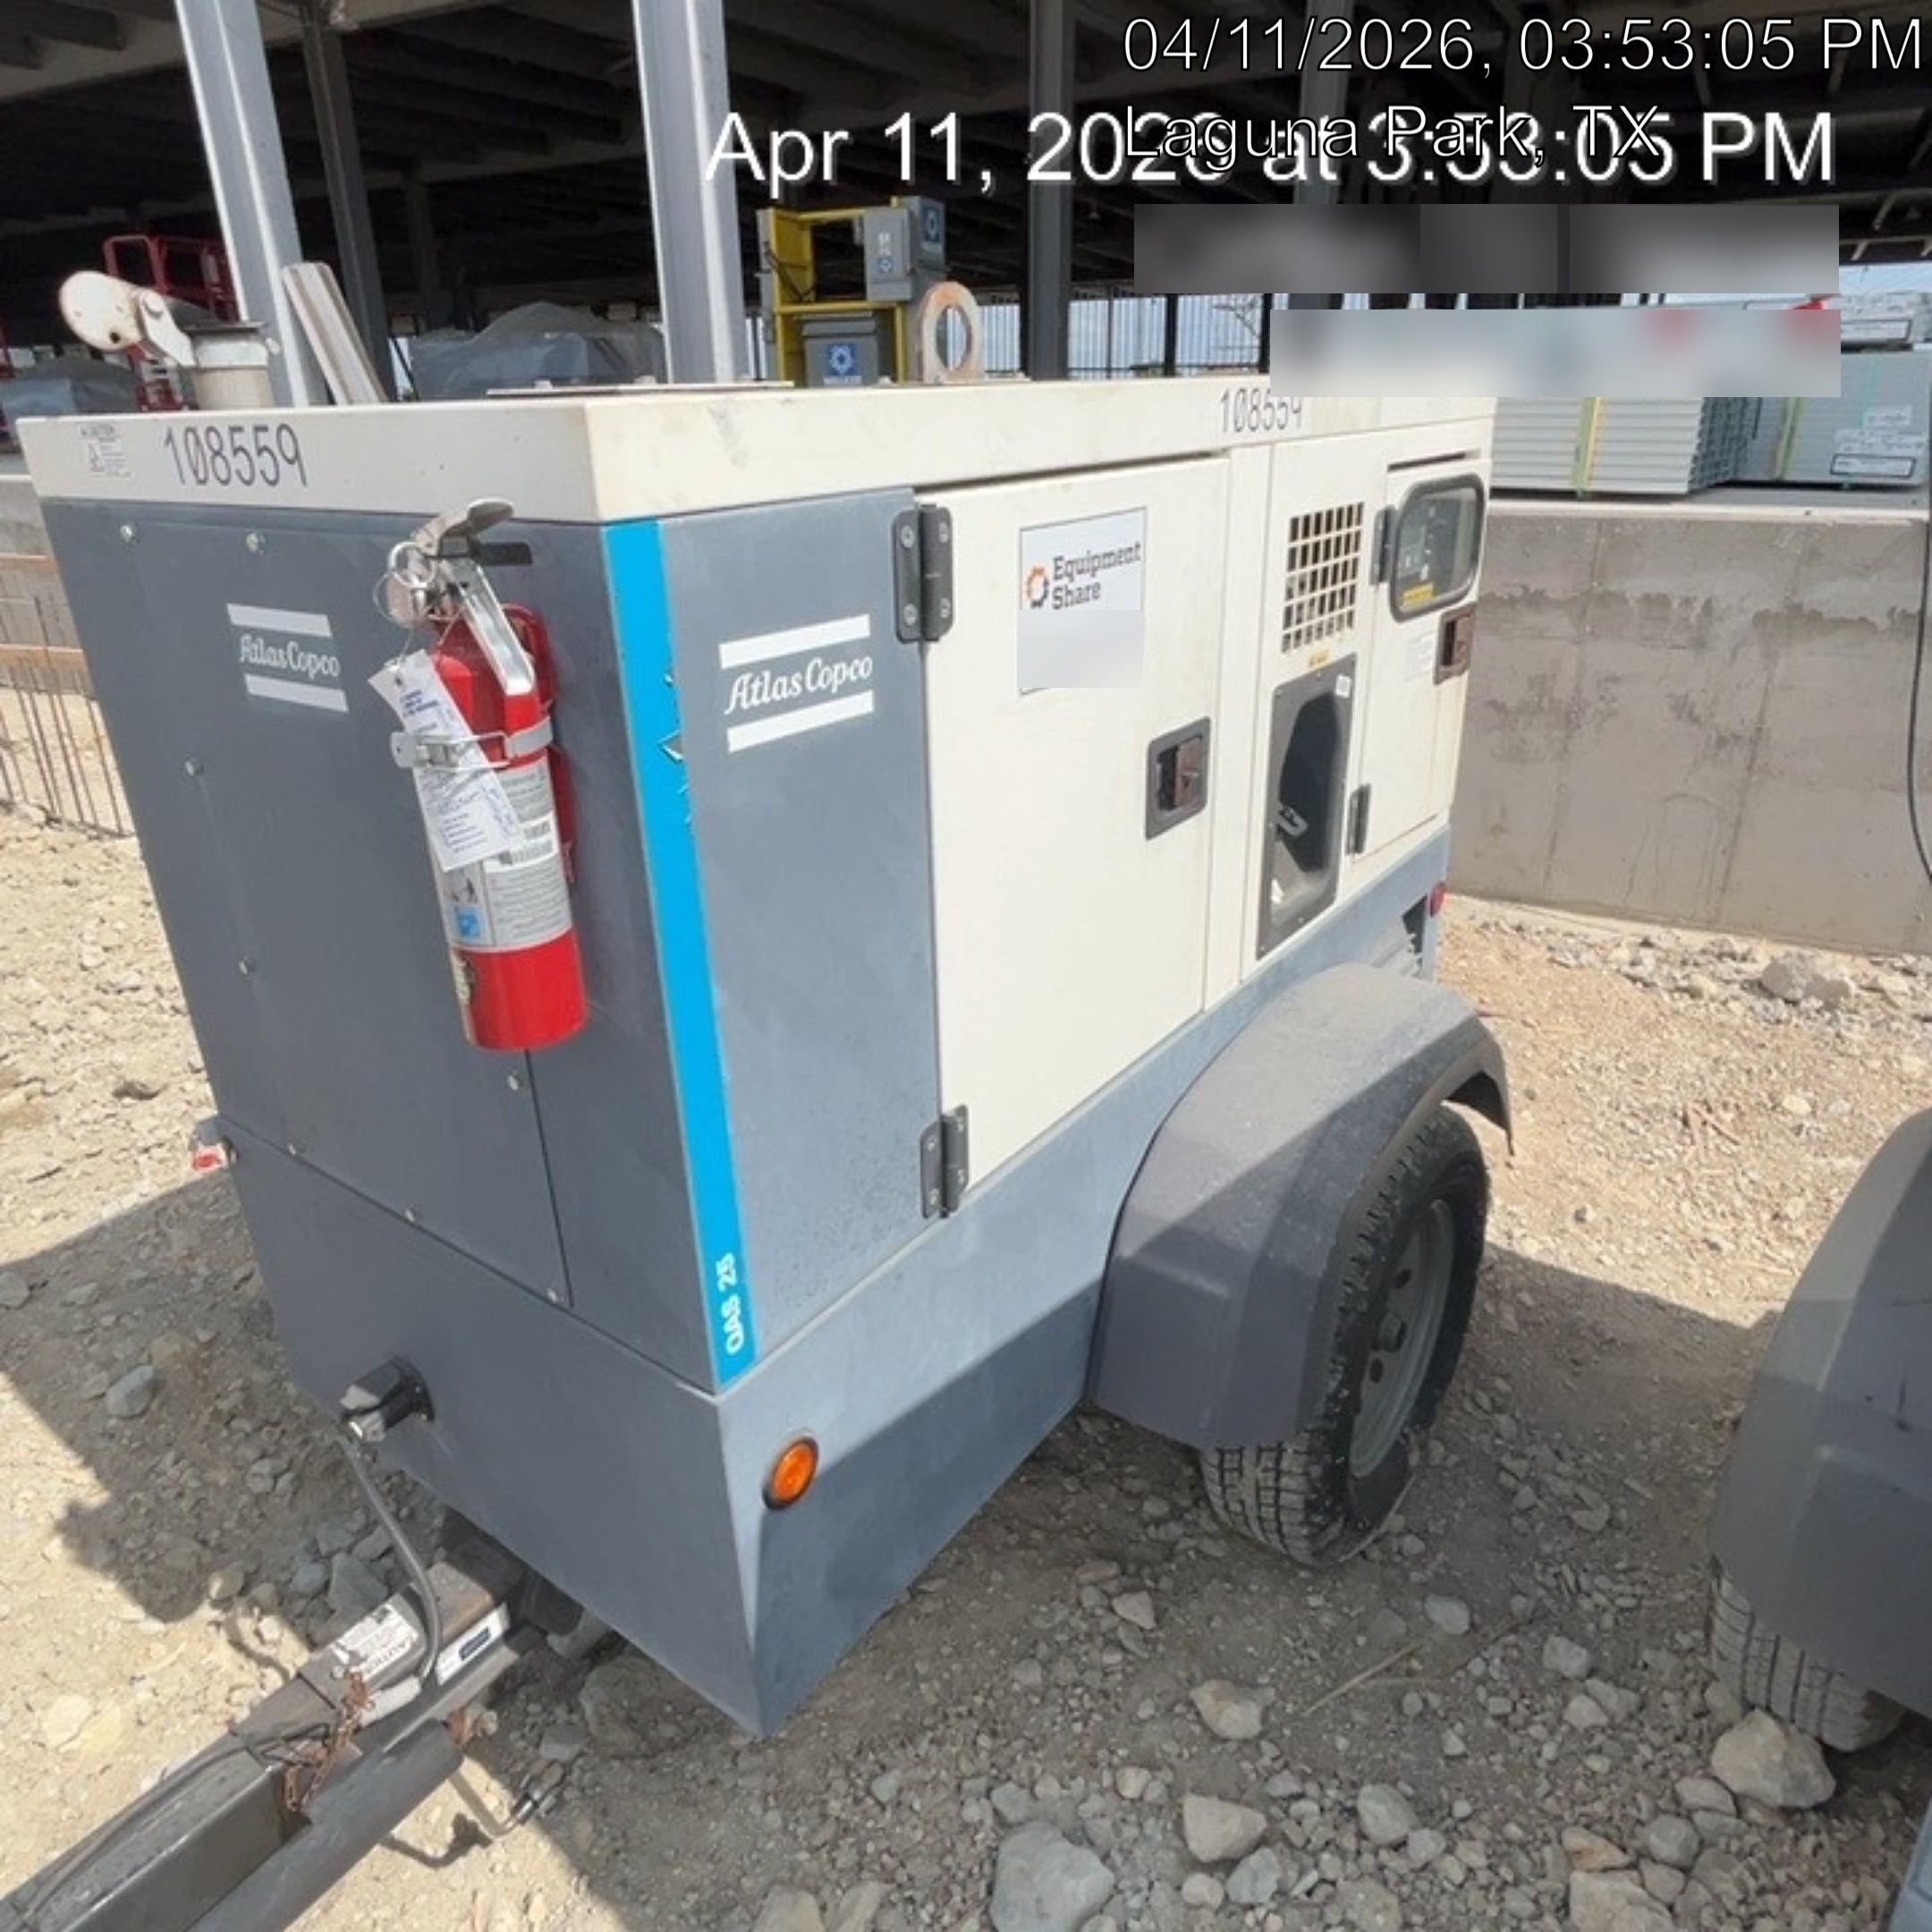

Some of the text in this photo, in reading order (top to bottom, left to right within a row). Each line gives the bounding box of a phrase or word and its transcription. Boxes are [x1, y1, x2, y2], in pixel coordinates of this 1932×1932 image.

[1218, 386, 1303, 433] 108559
[164, 422, 308, 487] 108559
[1053, 540, 1141, 583] Equipment
[1052, 581, 1101, 610] Share
[239, 633, 342, 681] Atlas Copco
[723, 655, 874, 716] Atlas Copco
[716, 1251, 737, 1292] 25
